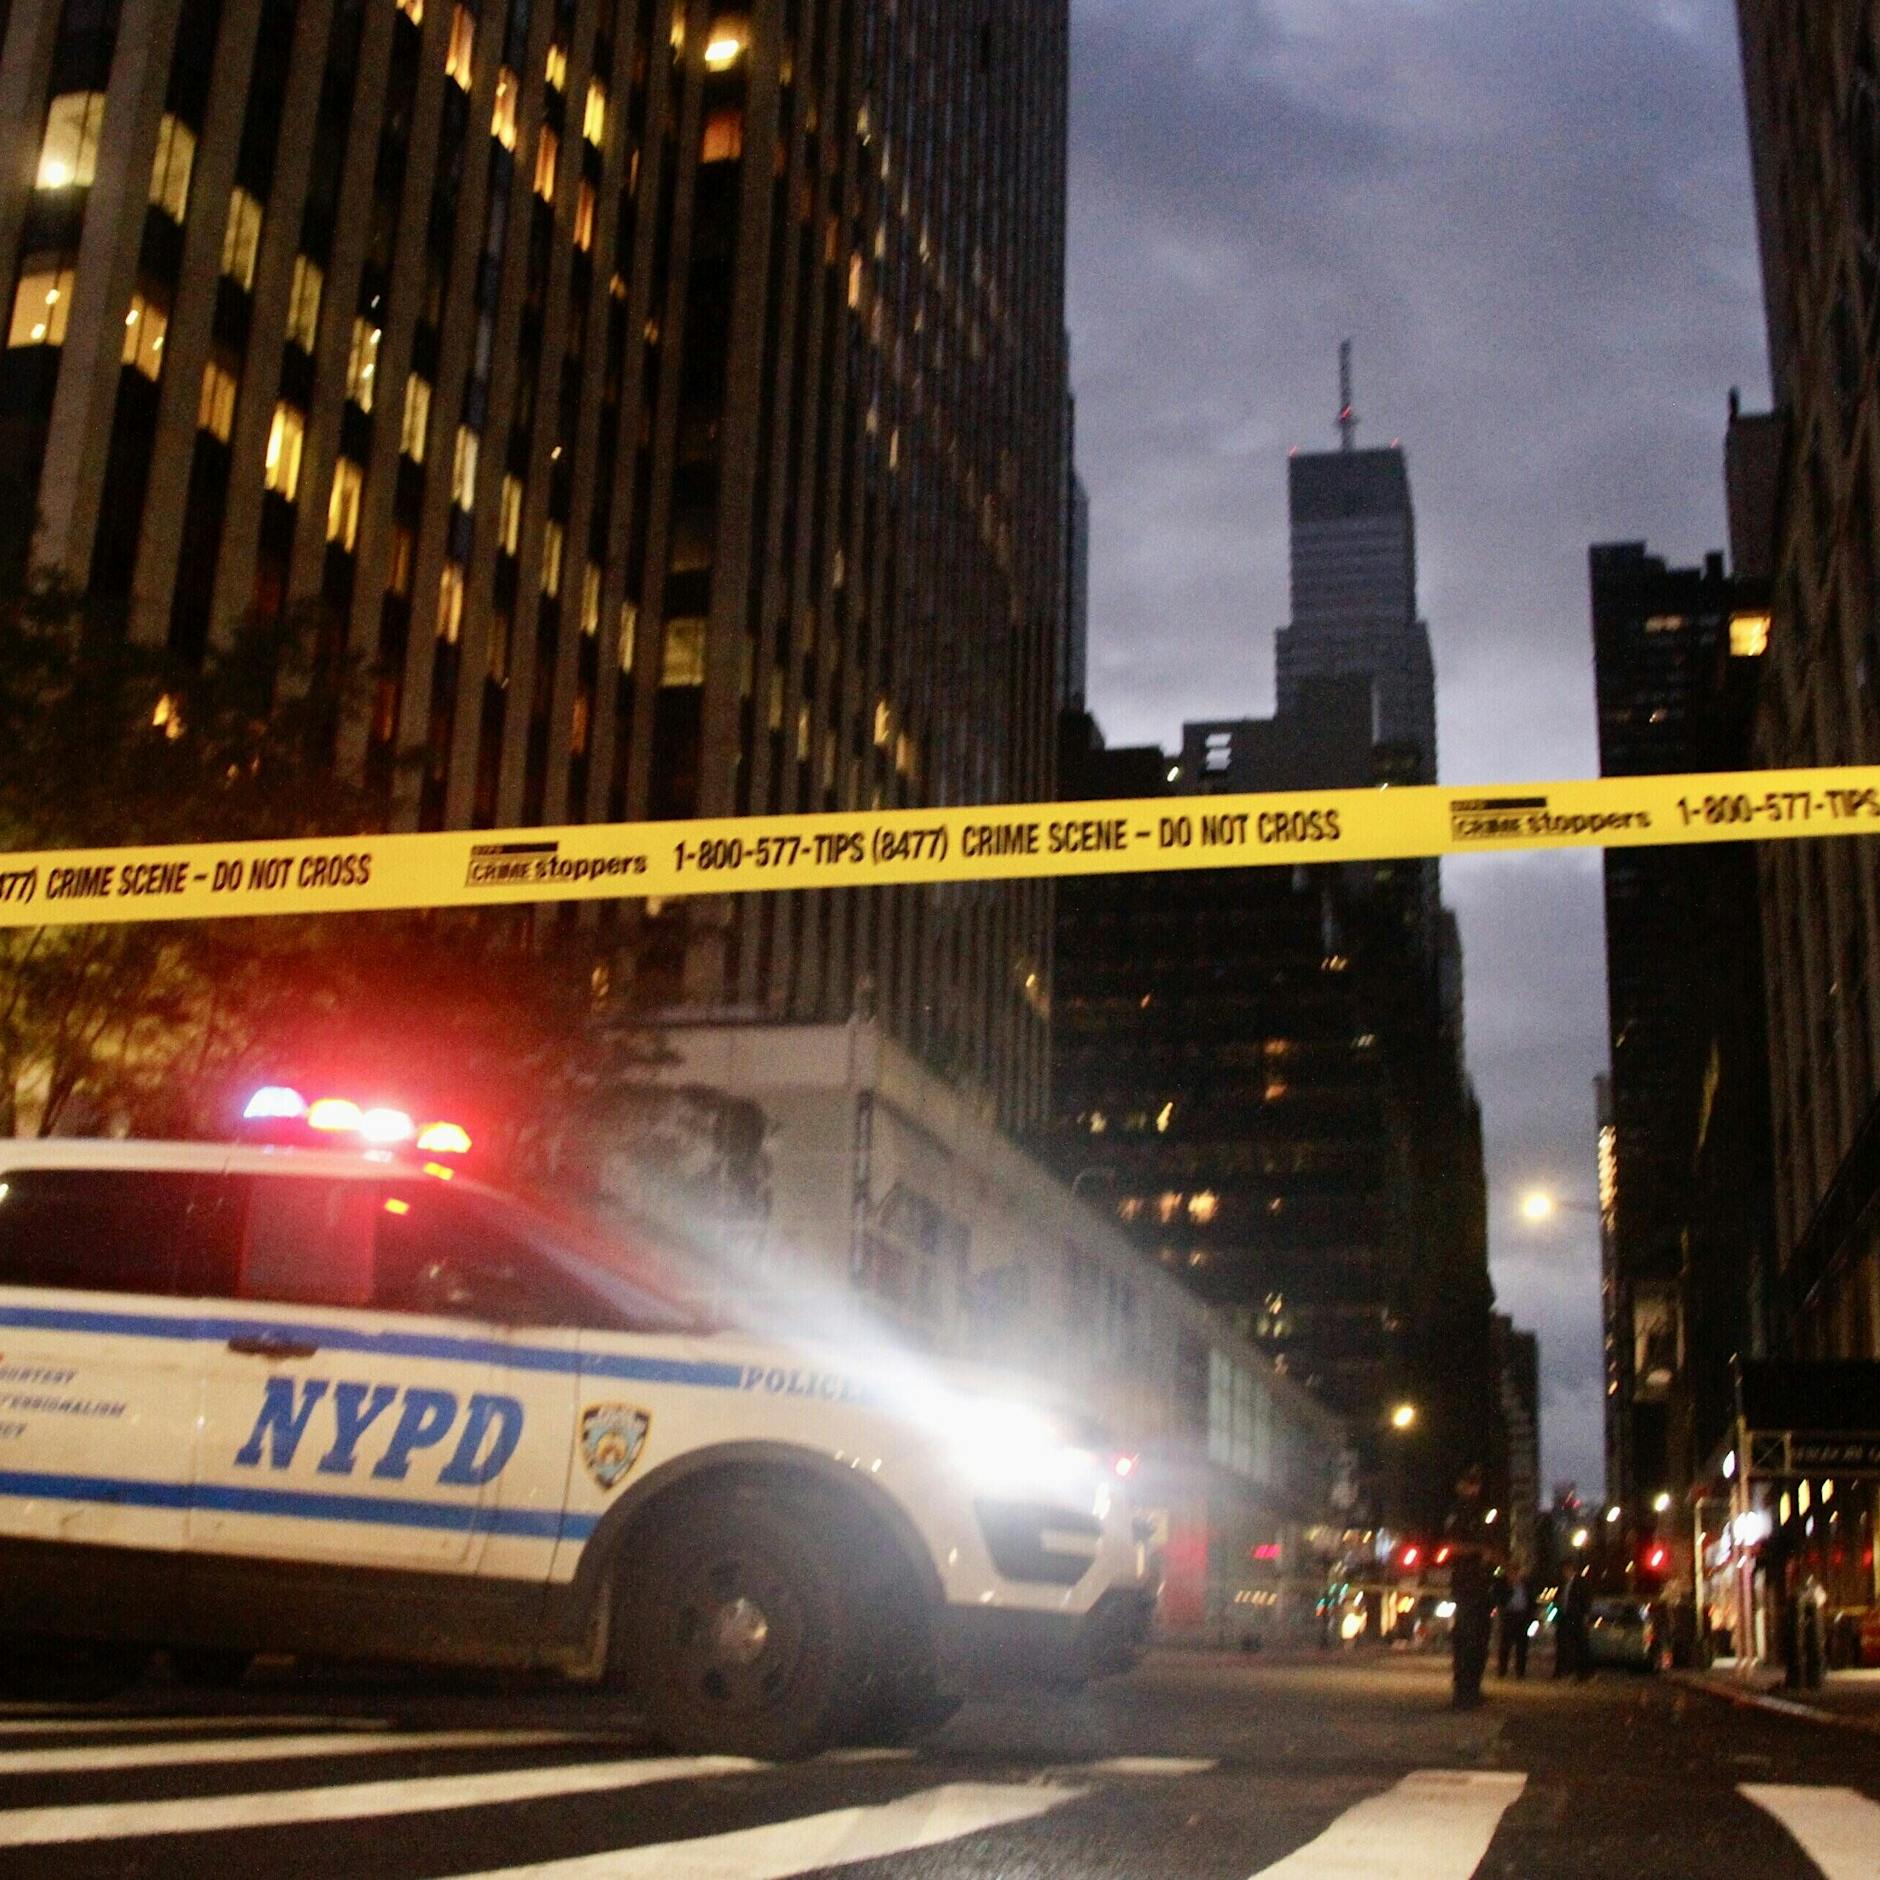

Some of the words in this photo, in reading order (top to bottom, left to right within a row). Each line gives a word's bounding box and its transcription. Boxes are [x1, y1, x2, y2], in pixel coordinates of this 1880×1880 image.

[1526, 811, 1651, 834] stoppers
[1677, 786, 1880, 827] 1-800-577-TIPS
[674, 830, 866, 871] 1-800-577-TIPS
[872, 824, 948, 865] (8477)
[962, 822, 1041, 857] CRIME
[1048, 819, 1128, 853] SCENE
[1159, 815, 1192, 848] DO
[1200, 813, 1249, 846] NOT
[1257, 808, 1341, 843] CROSS
[0, 866, 38, 904] 77)
[47, 865, 117, 899] CRIME
[118, 862, 190, 896] SCENE
[211, 859, 244, 891] DO
[247, 857, 295, 889] NOT
[298, 852, 371, 887] CROSS
[534, 854, 648, 881] stoppers
[234, 1376, 525, 1486] NYPD
